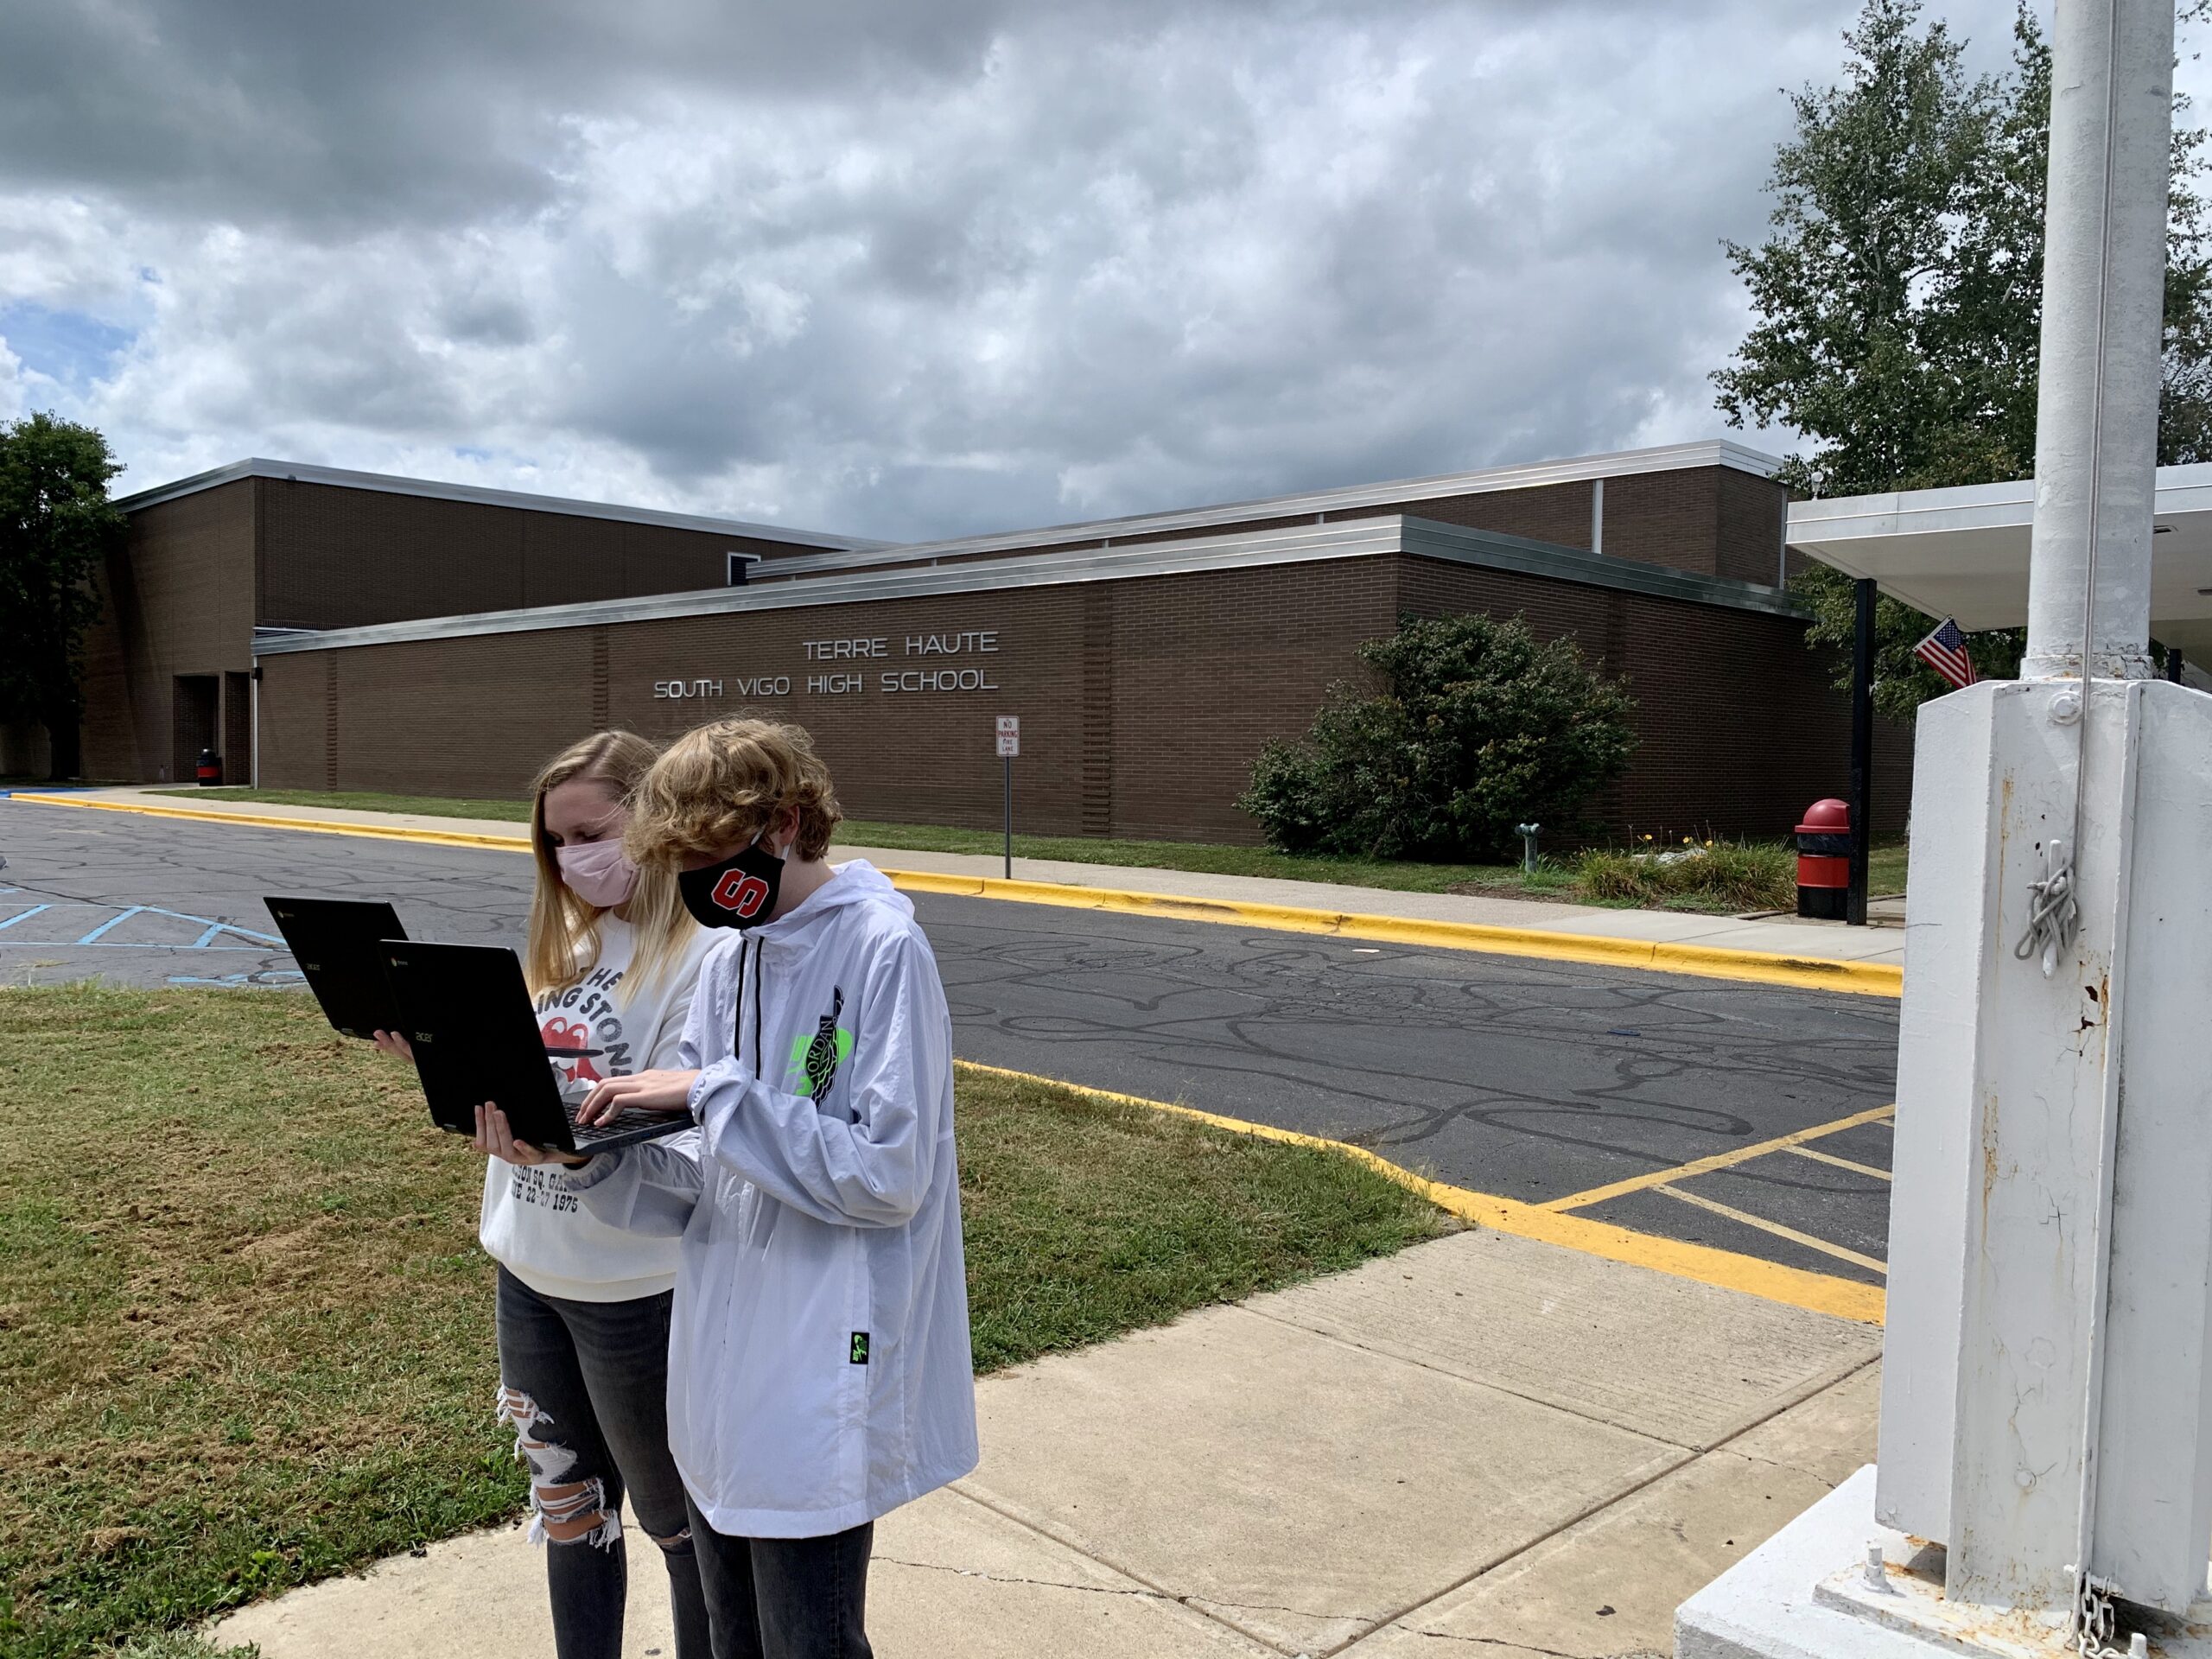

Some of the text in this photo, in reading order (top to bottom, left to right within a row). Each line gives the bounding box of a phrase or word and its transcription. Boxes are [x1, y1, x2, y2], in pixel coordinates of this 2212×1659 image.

[803, 631, 999, 660] TERRE HAUTE
[654, 669, 999, 698] SOUTH VIGO HIGH SCHOOL
[711, 868, 769, 918] S
[576, 966, 624, 991] THE
[534, 988, 632, 1077] ING STON
[807, 1020, 833, 1079] JORDAN
[553, 1193, 579, 1213] 1975
